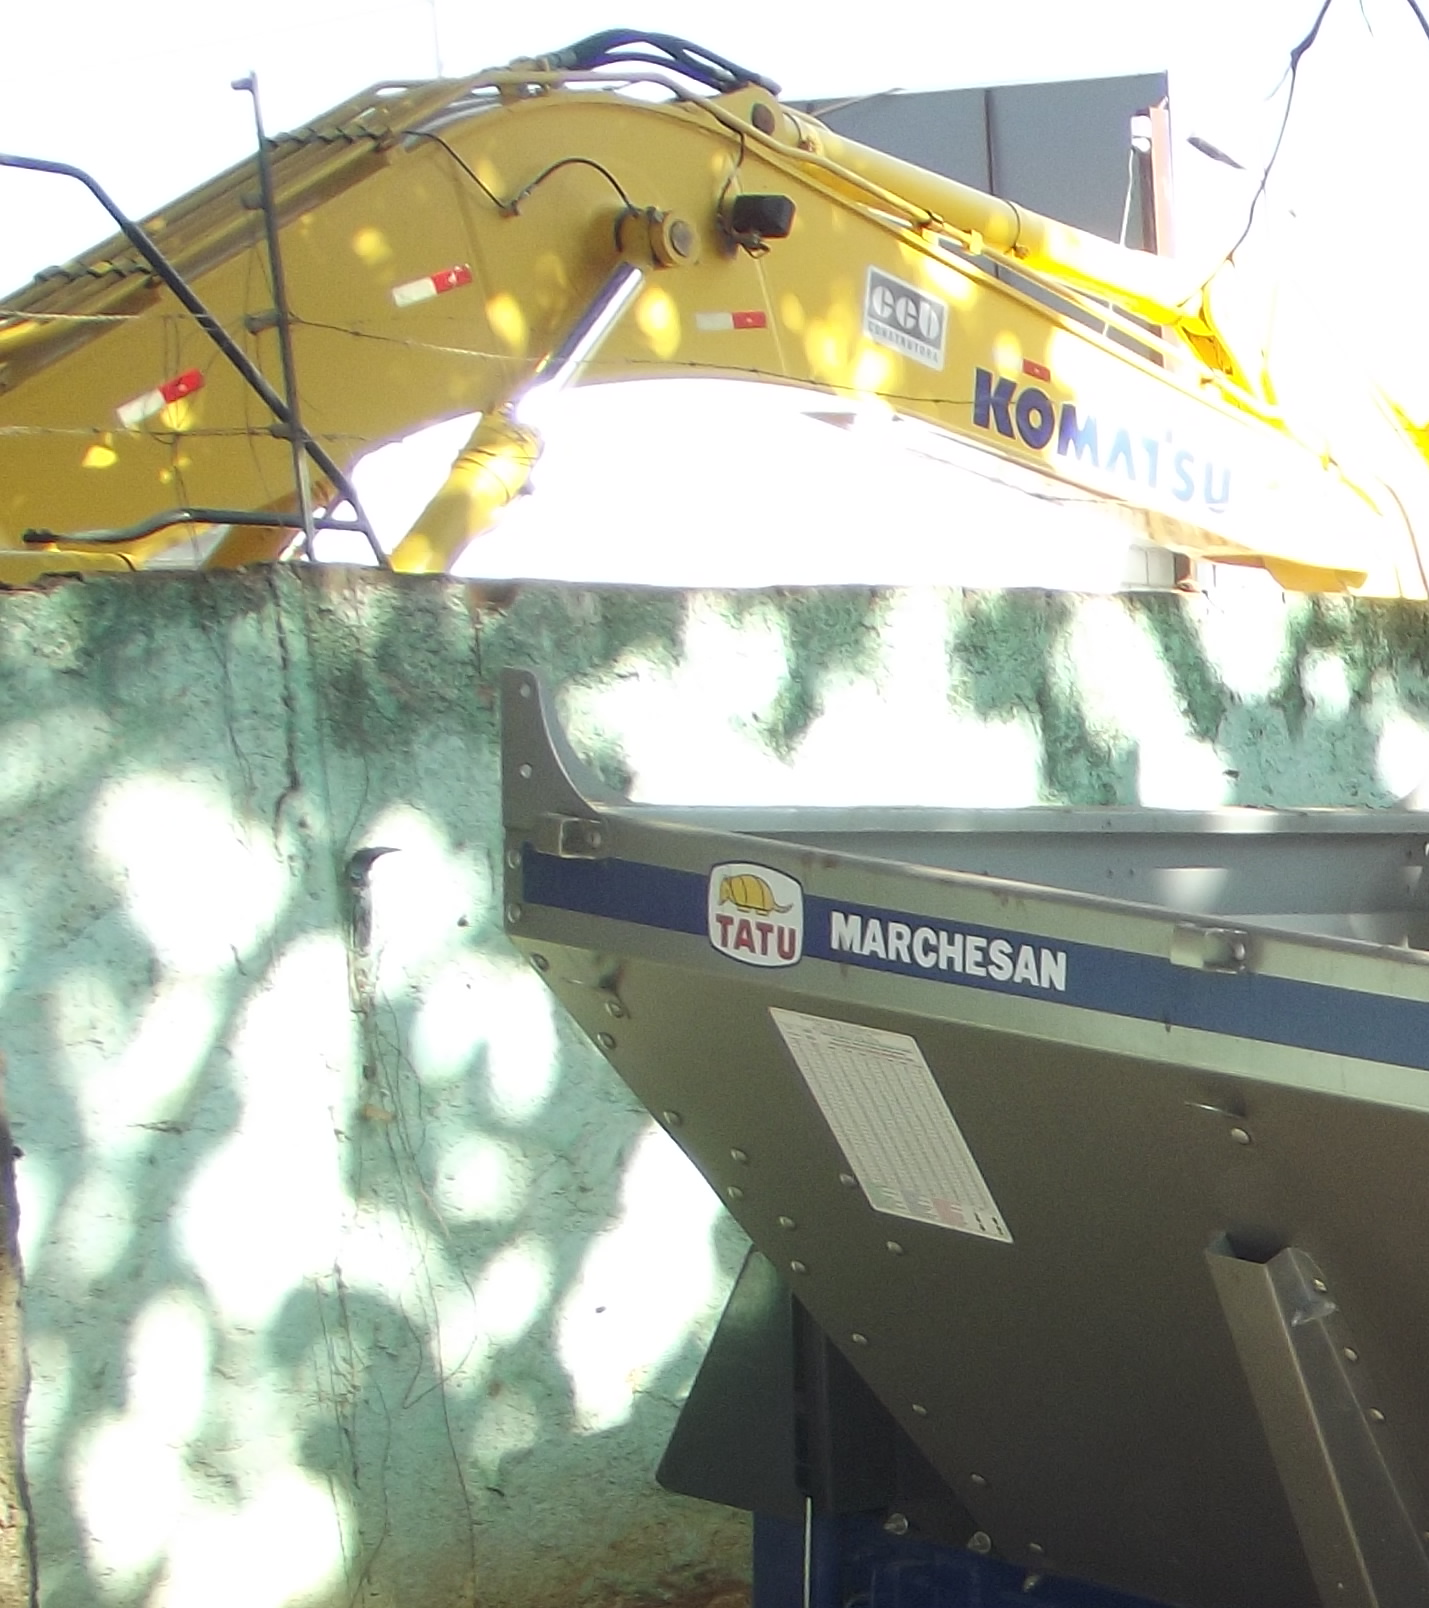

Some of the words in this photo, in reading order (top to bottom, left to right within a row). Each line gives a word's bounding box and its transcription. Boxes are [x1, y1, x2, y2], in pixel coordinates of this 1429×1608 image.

[973, 366, 1231, 514] KOMATSU
[715, 912, 797, 961] TATU
[830, 910, 1067, 992] MARCHESAN
